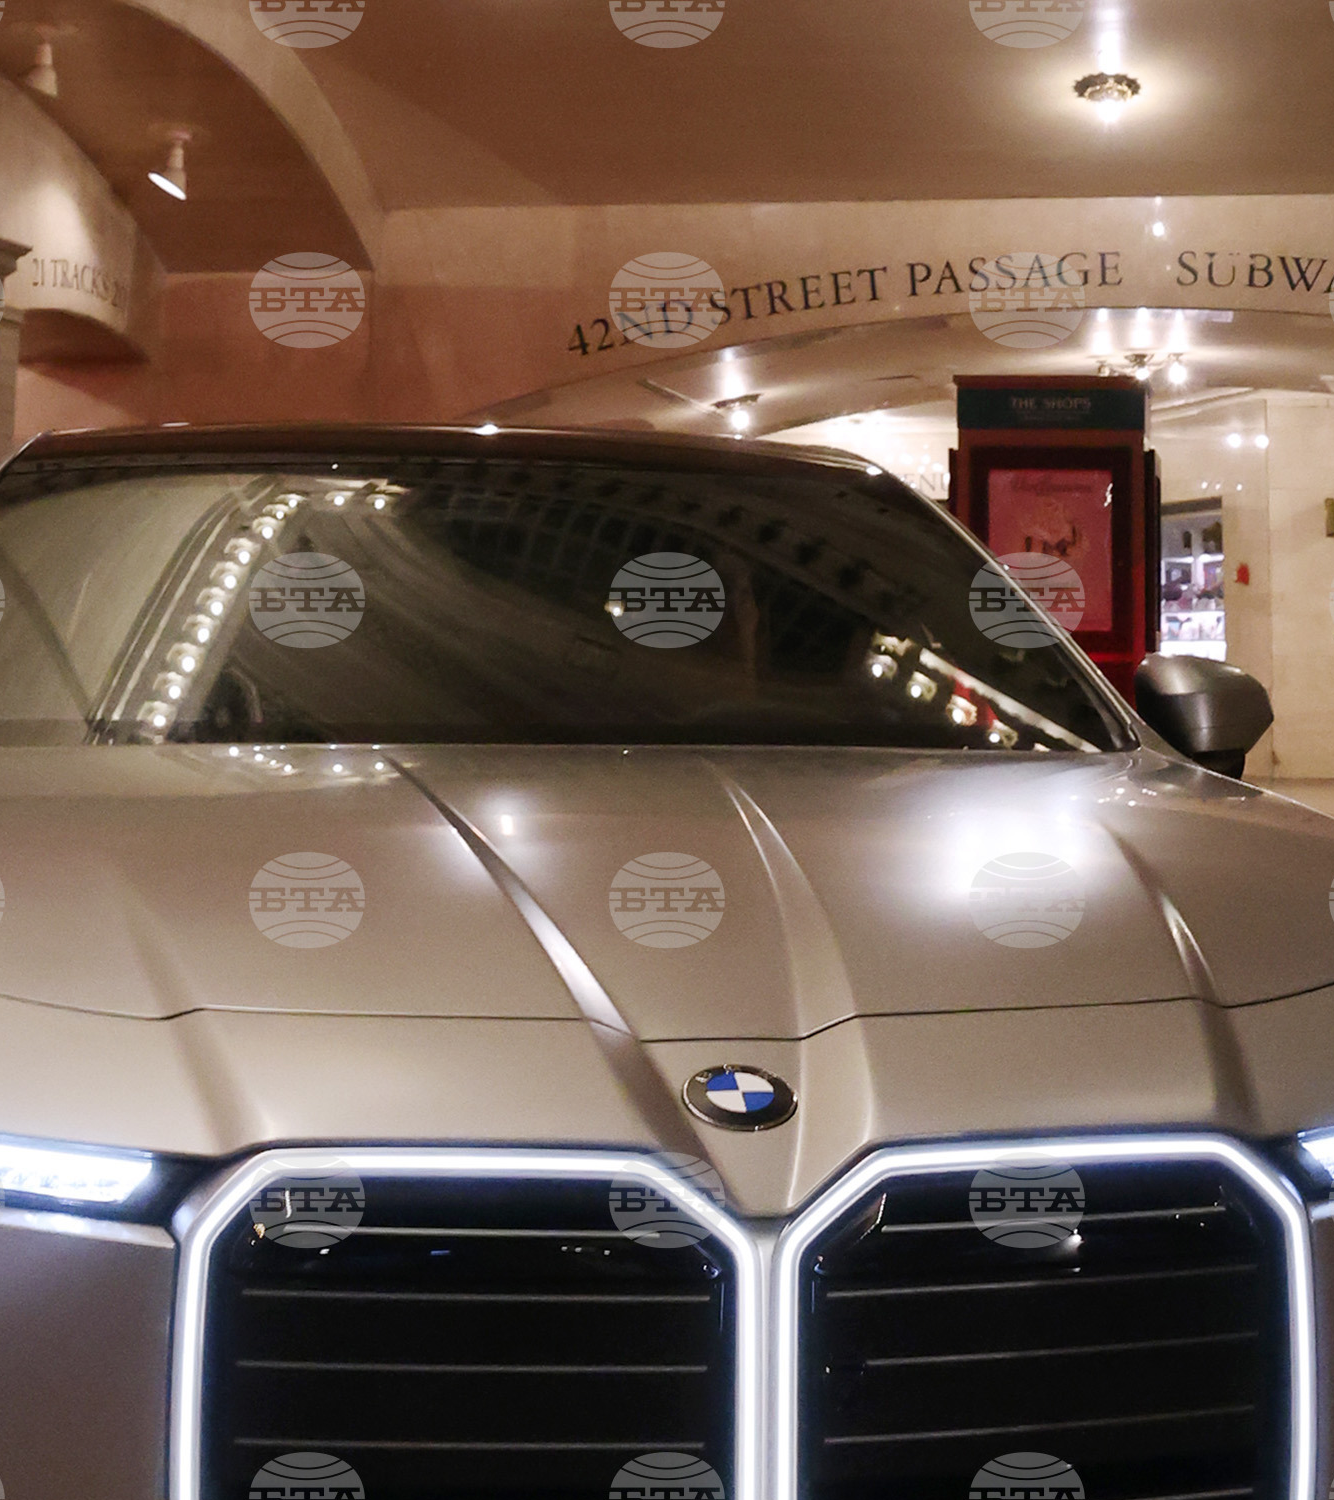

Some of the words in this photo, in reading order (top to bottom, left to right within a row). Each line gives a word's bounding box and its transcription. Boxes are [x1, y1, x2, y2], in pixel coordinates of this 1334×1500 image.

[567, 299, 694, 356] 42ND
[708, 265, 888, 326] STREET
[906, 250, 1124, 298] PASSAGE
